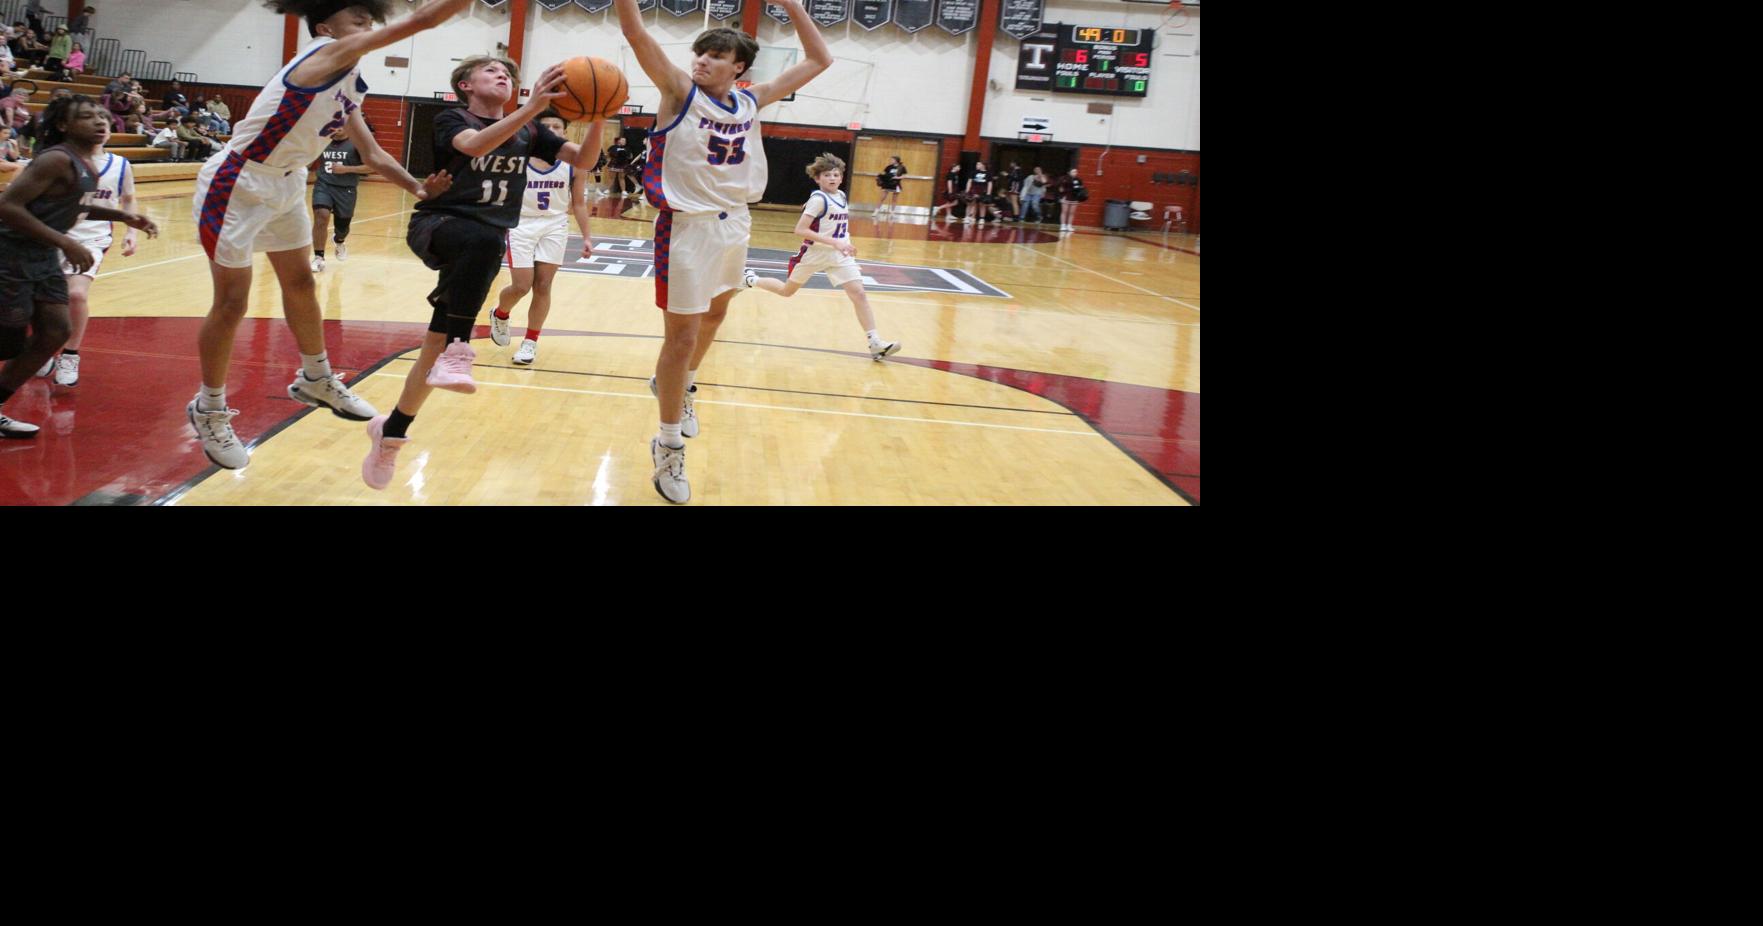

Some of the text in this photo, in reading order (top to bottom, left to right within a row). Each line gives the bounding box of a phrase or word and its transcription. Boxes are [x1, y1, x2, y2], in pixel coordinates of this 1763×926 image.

[1079, 29, 1101, 41] 49
[1022, 44, 1054, 69] T
[1075, 49, 1088, 63] 6
[1135, 53, 1148, 67] 5
[1057, 63, 1089, 71] HOME
[1102, 60, 1108, 71] 1
[1134, 80, 1145, 91] 0
[707, 135, 746, 165] 53
[470, 155, 526, 174] WEST
[477, 180, 509, 206] 11
[537, 192, 550, 210] 5
[832, 223, 847, 238] 13
